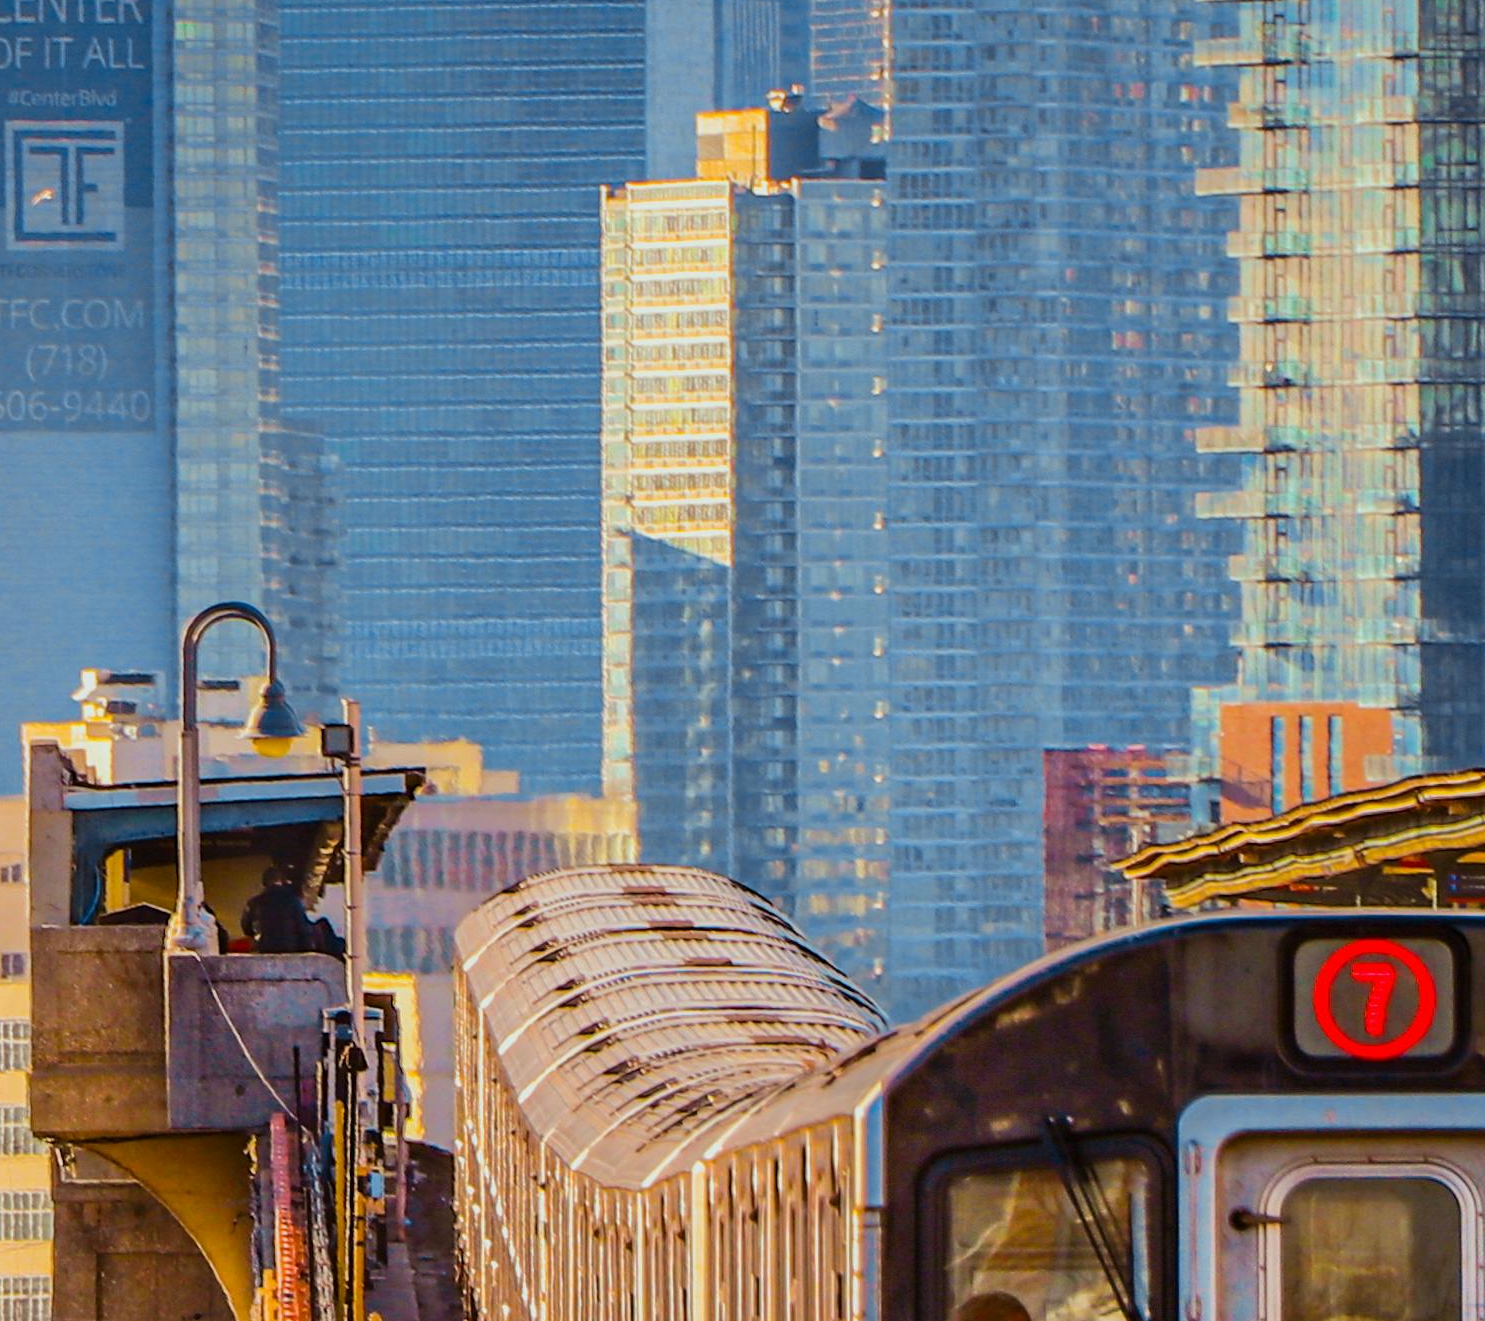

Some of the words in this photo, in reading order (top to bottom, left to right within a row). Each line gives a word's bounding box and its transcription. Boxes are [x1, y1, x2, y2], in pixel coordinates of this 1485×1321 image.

[44, 36, 74, 69] IT
[82, 37, 146, 70] ALL
[26, 344, 108, 382] (718)
[1351, 961, 1397, 1037] 7
